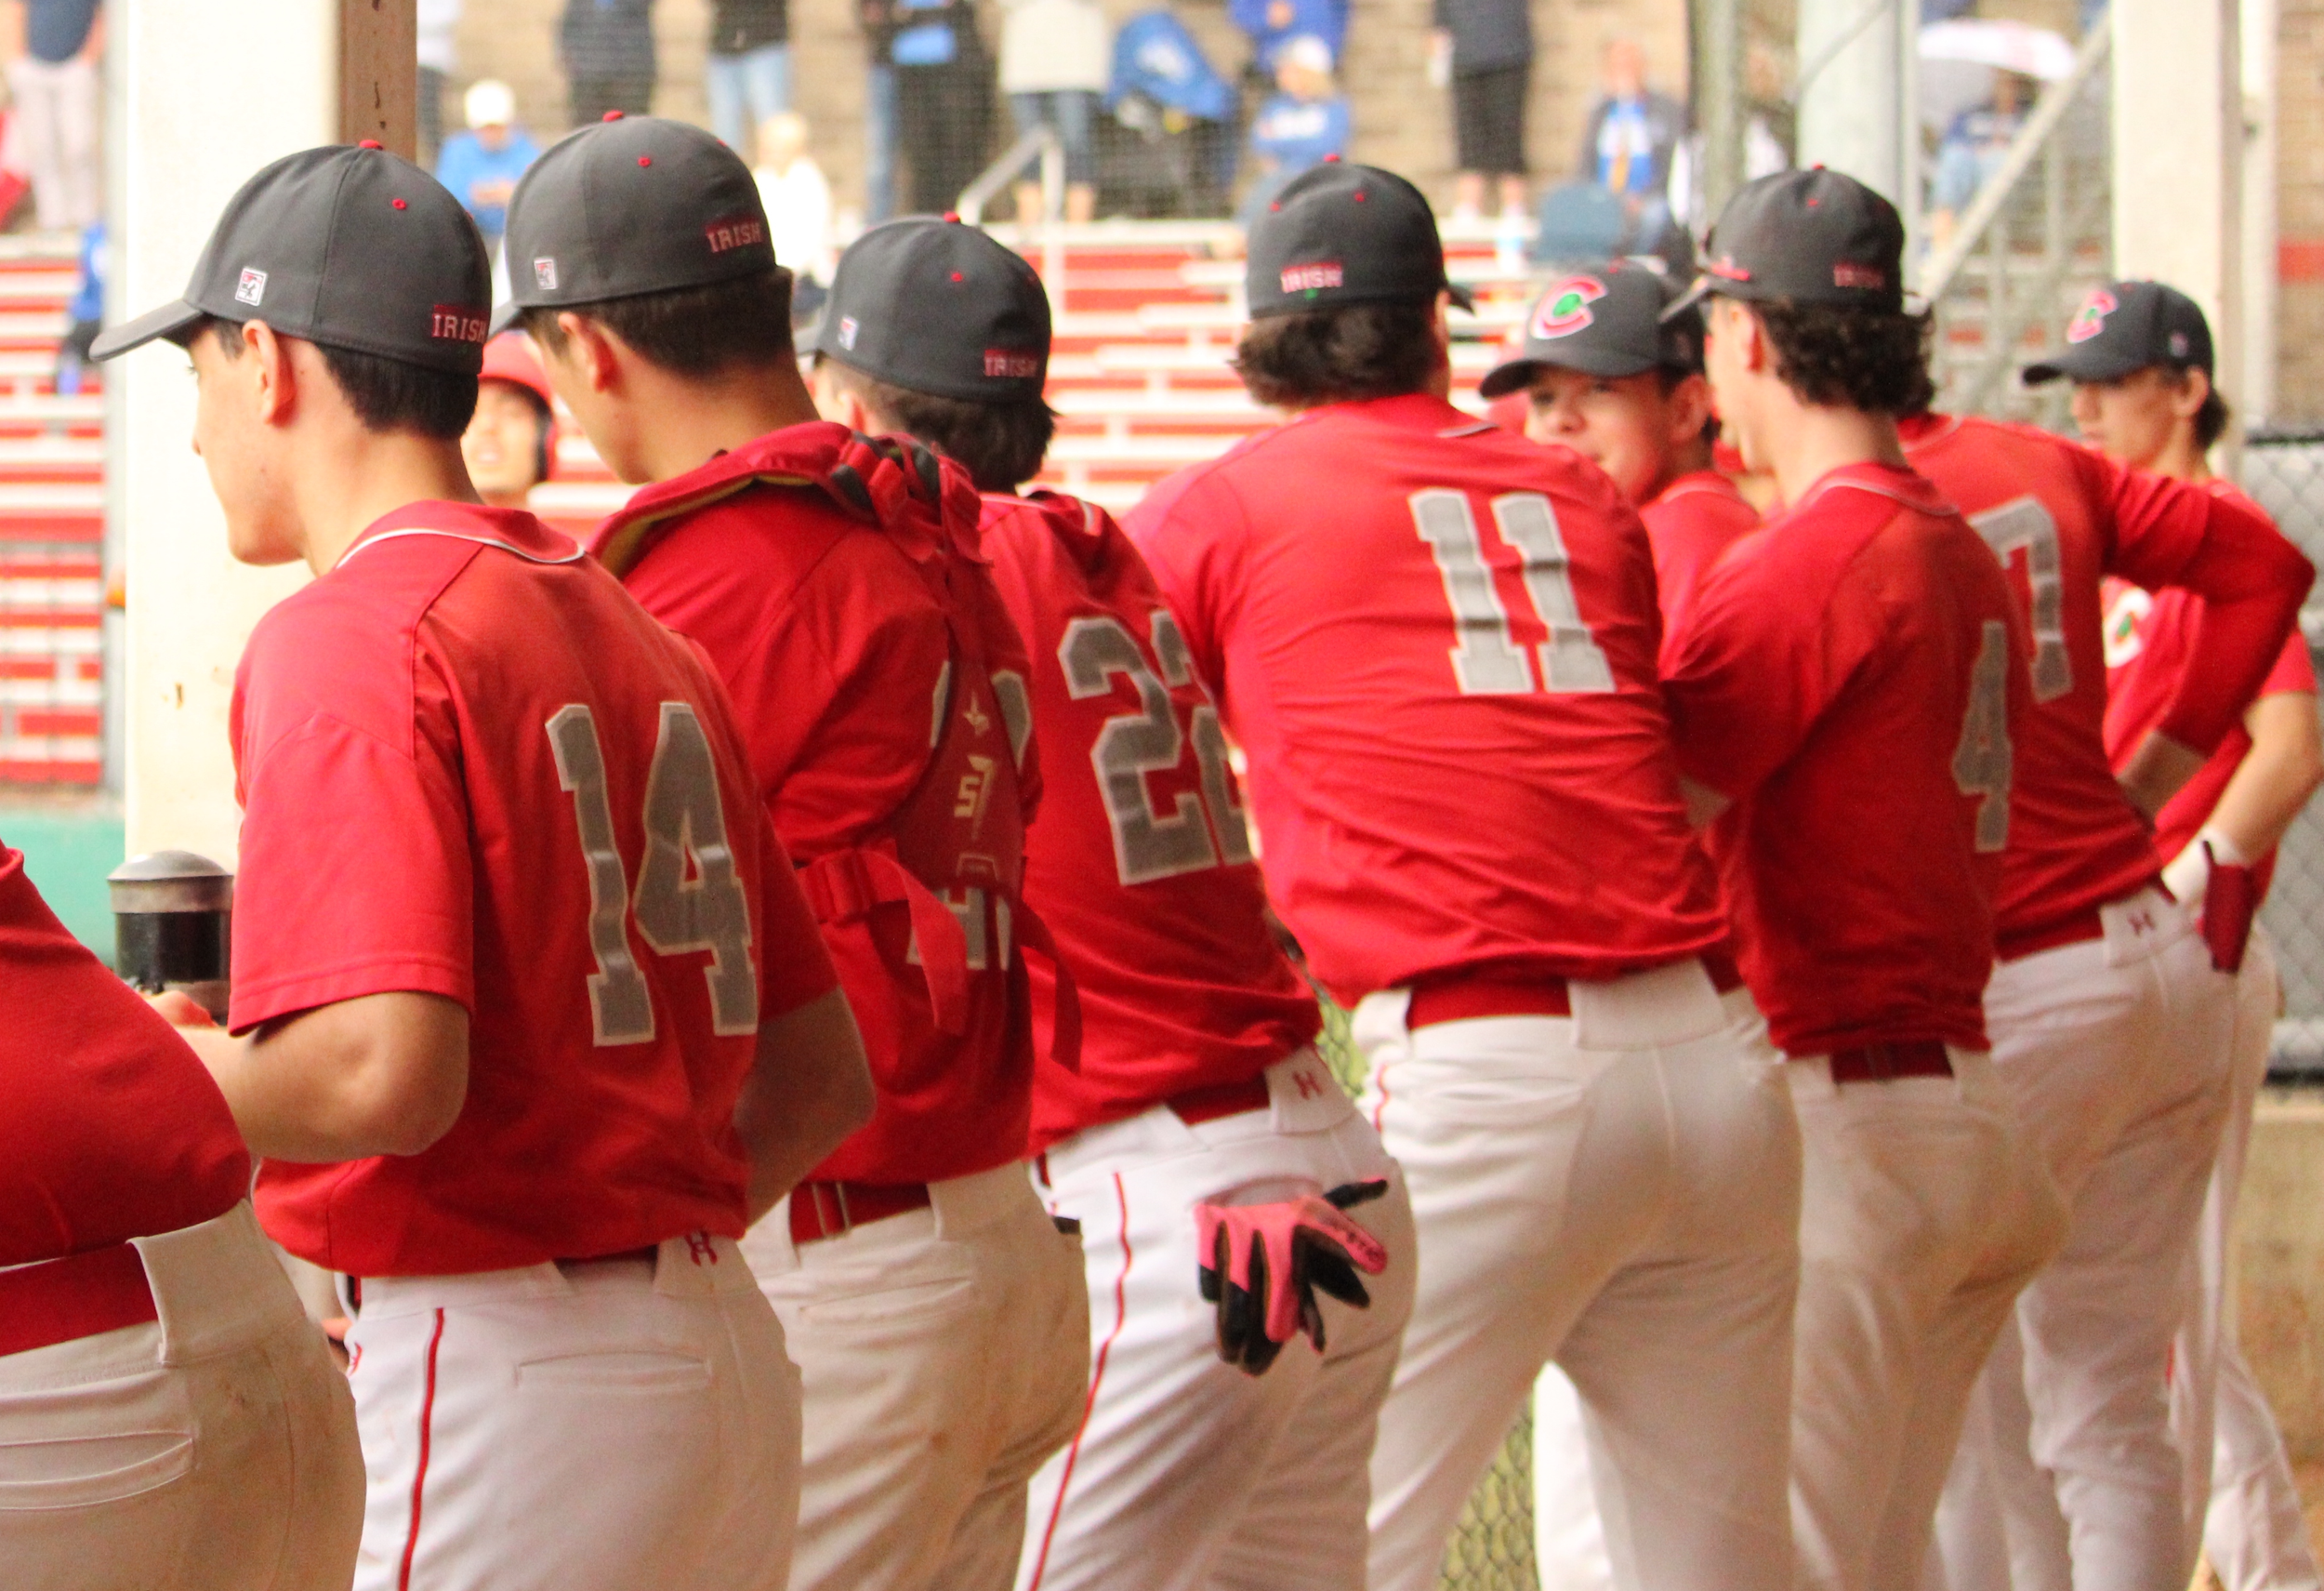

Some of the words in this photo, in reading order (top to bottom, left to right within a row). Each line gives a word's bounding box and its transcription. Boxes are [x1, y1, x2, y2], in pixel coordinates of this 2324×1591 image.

[431, 313, 488, 344] IRISH
[706, 221, 762, 253] IRISH
[1280, 266, 1342, 293] IRISH
[1406, 487, 1616, 694] 11
[1967, 494, 2073, 704] 7
[1951, 618, 2012, 853] 4
[546, 701, 759, 1047] 14
